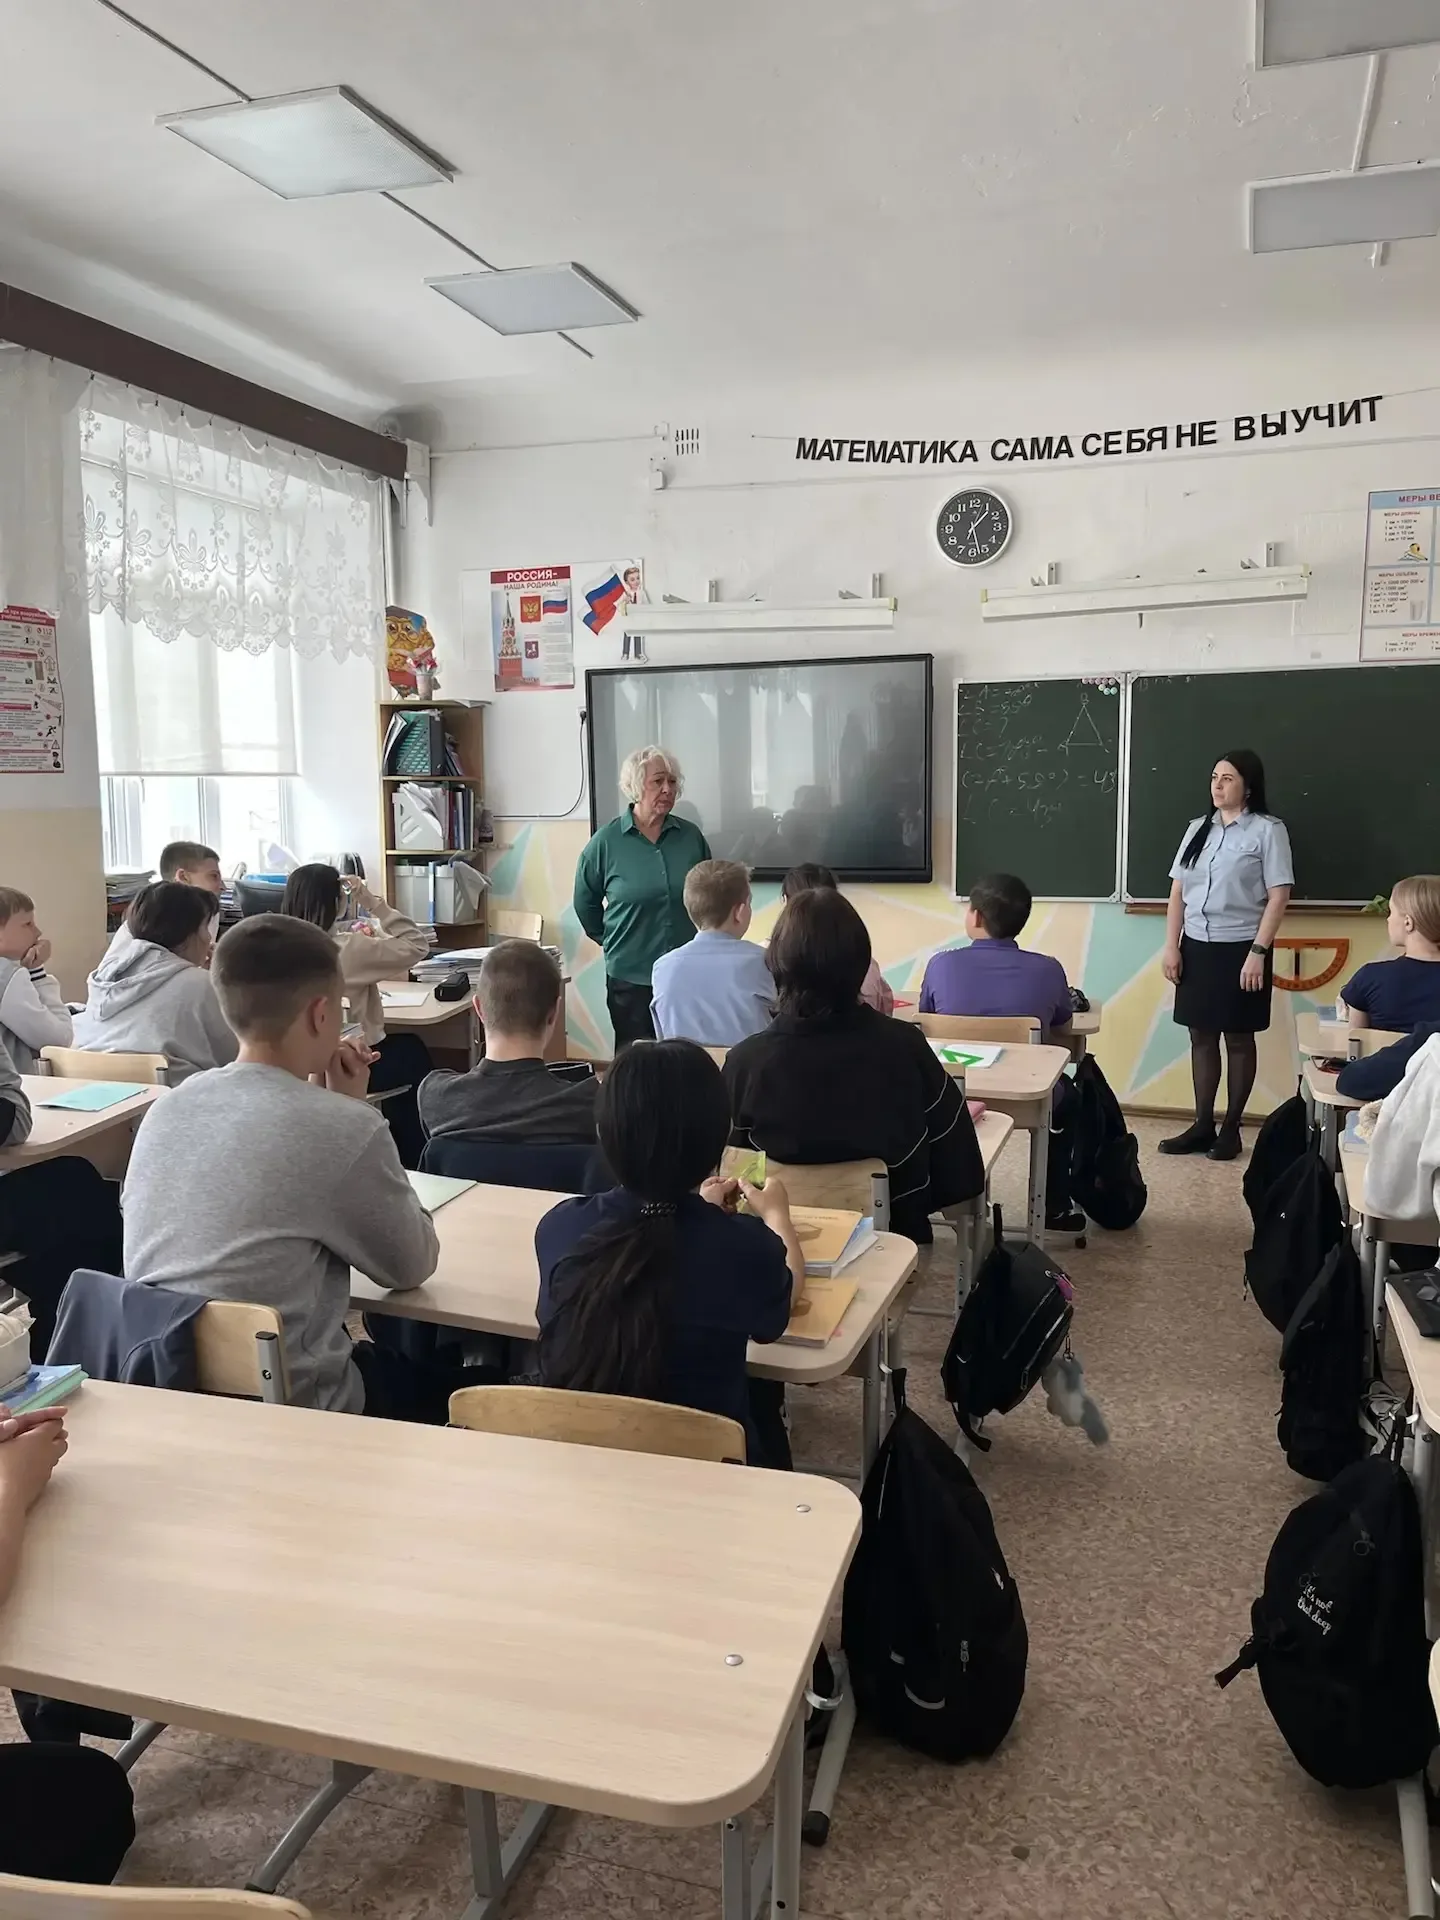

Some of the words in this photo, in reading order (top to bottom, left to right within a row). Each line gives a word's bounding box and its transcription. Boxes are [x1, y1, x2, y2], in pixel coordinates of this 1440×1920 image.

[796, 437, 978, 463] МАТЕМАТИКА
[990, 438, 1074, 461] САМА
[1081, 426, 1168, 457] СЕБЯ
[1176, 420, 1218, 449] НЕ
[1234, 395, 1384, 441] ВЫУЧИТ
[958, 503, 966, 512] 11
[969, 498, 981, 508] 12
[949, 513, 961, 522] 10
[991, 511, 1000, 520] 2
[945, 525, 954, 534] 9
[993, 522, 1002, 531] 3
[948, 536, 957, 545] 8
[989, 535, 996, 543] 4
[957, 545, 966, 554] 7
[968, 548, 977, 557] 6
[981, 544, 989, 553] 5
[507, 569, 558, 582] РОССИЯ-
[1311, 1609, 1332, 1635] deep
